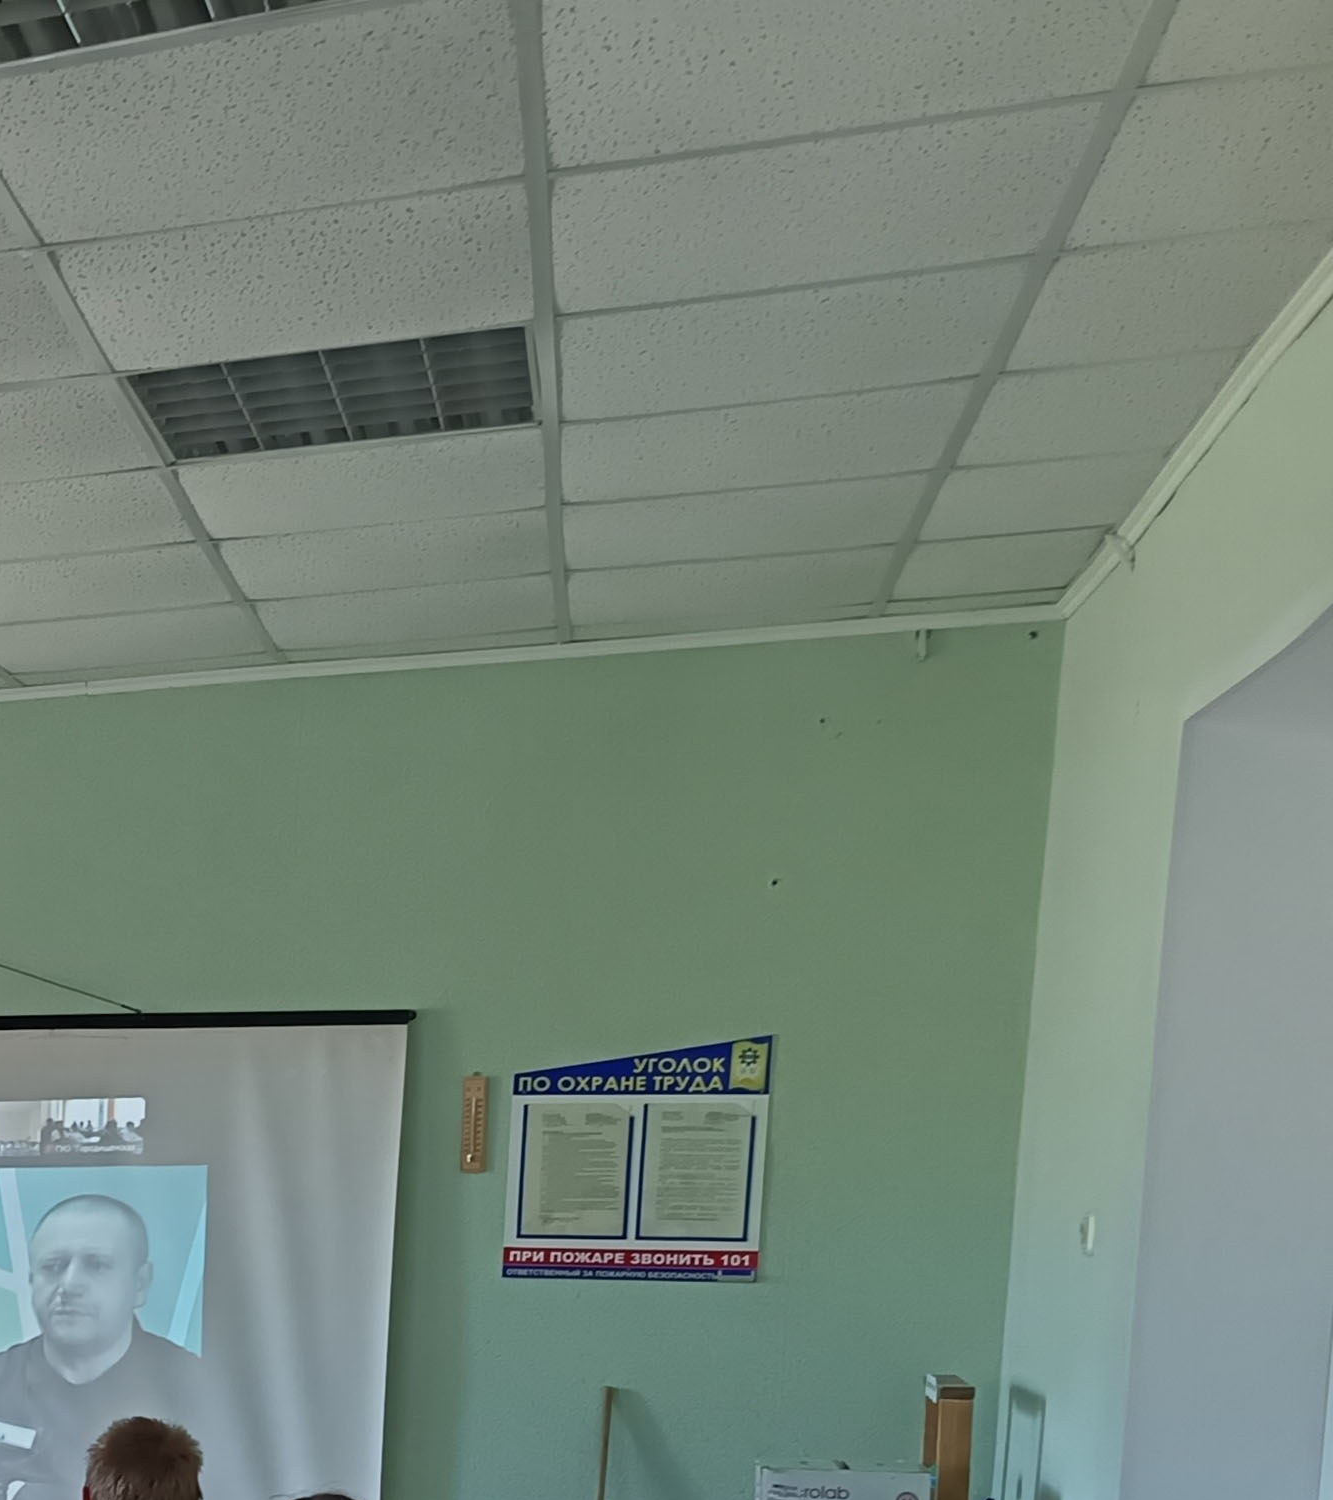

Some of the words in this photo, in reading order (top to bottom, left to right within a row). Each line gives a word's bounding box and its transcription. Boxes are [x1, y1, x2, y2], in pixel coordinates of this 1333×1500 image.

[633, 1057, 725, 1074] УГОЛОК
[518, 1076, 551, 1092] ПО
[557, 1076, 646, 1092] ОХРАНЕ
[652, 1075, 724, 1093] ТРУДА
[508, 1250, 545, 1263] ПРИ
[549, 1251, 625, 1265] ПОЖАРЕ
[630, 1253, 715, 1266] ЗВОНИТЬ
[720, 1255, 751, 1266] 101
